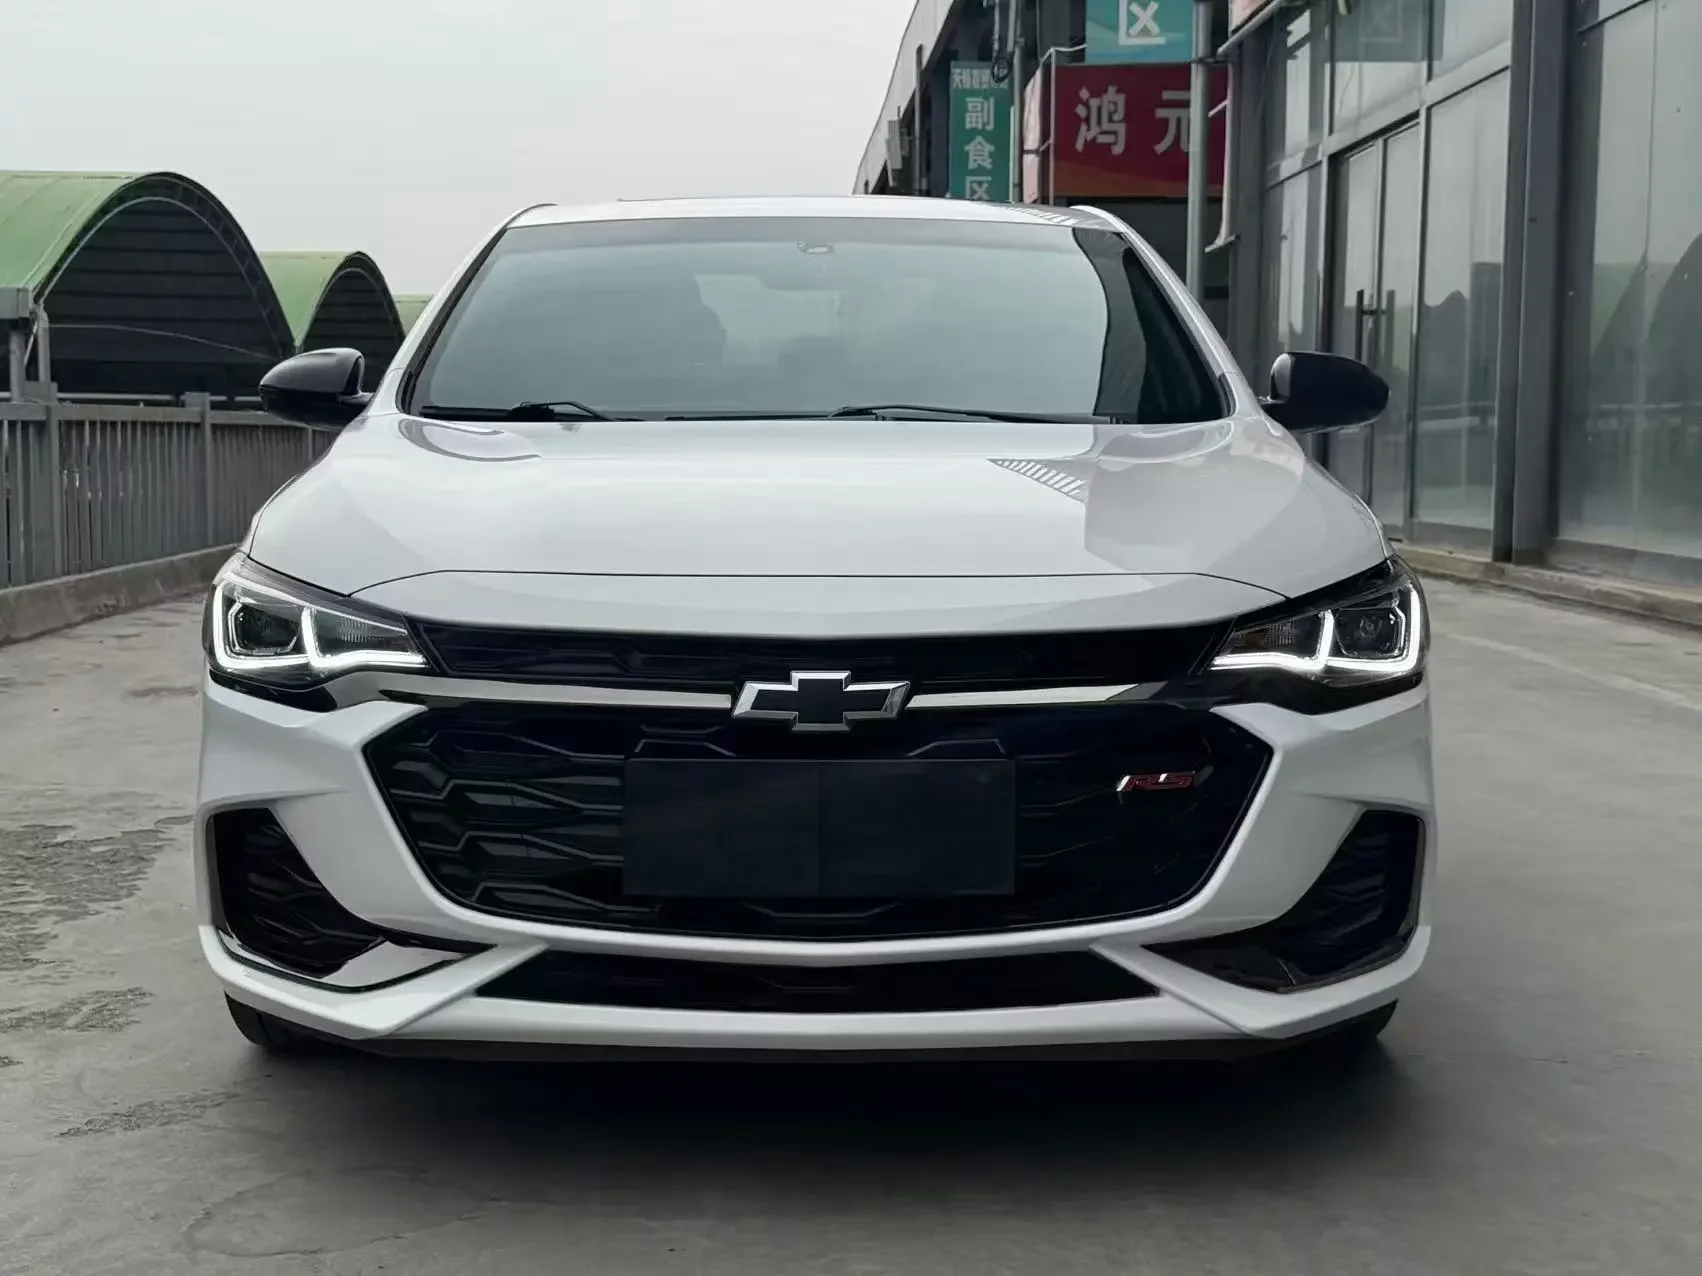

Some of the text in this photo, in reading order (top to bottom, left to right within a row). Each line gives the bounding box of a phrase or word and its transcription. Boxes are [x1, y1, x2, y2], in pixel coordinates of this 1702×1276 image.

[1119, 0, 1165, 45] 区
[964, 97, 995, 200] 副食区
[1075, 86, 1190, 155] 鸿元
[1116, 772, 1194, 791] RS
